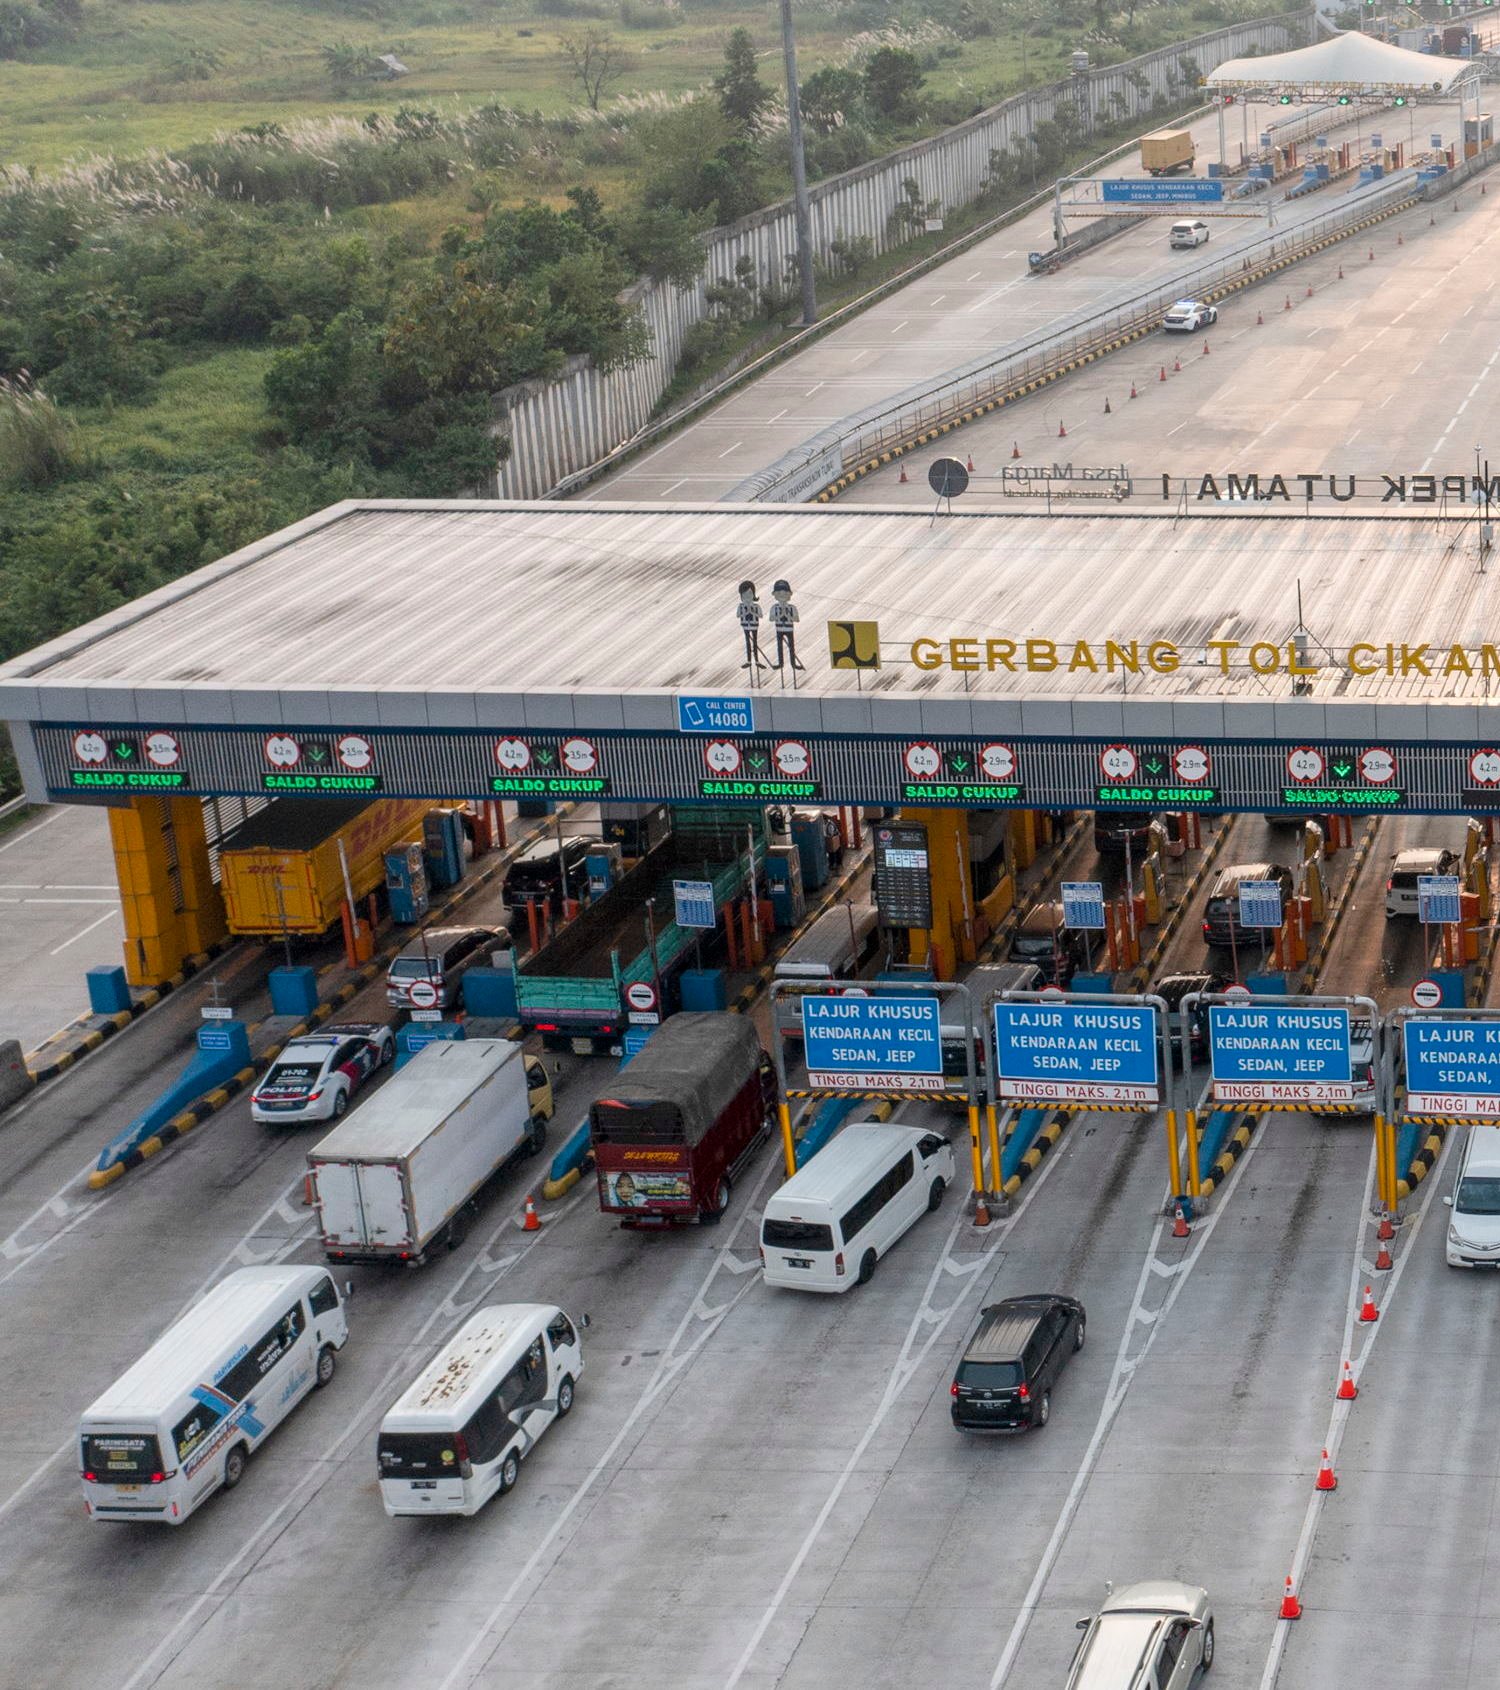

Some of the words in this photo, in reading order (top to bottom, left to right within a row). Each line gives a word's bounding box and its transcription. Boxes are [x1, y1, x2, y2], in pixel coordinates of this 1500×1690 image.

[910, 637, 1180, 675] GERBANG
[1207, 641, 1318, 676] TOL
[705, 701, 722, 710] CALL
[724, 702, 746, 711] CENTER
[708, 713, 748, 727] 14080
[74, 774, 124, 785] SALDO
[128, 775, 181, 785] CUKUP
[266, 776, 317, 787] SALDO
[321, 778, 374, 789] CUKUP
[494, 780, 545, 790] SALDO
[549, 780, 603, 791] CUKUP
[704, 783, 755, 794] SALDO
[760, 784, 814, 795] CUKUP
[906, 786, 958, 797] SALDO
[963, 787, 1018, 798] CUKUP
[1100, 789, 1153, 800] SALDO
[1157, 790, 1213, 800] CUKUP
[247, 864, 286, 874] DHL
[808, 1004, 860, 1018] LAJUR
[868, 1005, 933, 1019] KHUSUS
[1009, 1013, 1062, 1027] LAJUR
[1074, 1015, 1142, 1030] KHUSUS
[1216, 1015, 1268, 1028] LAJUR
[1277, 1015, 1343, 1029] KHUSUS
[809, 1026, 891, 1040] KENDARAAN
[898, 1028, 935, 1041] KECIL
[1419, 1030, 1474, 1043] LAJUR
[1011, 1036, 1097, 1050] KENDARAAN
[1105, 1039, 1142, 1052] KECIL
[1217, 1037, 1300, 1050] KENDARAAN
[1307, 1038, 1344, 1051] KECIL
[832, 1048, 880, 1062] SEDAN,
[885, 1050, 916, 1062] JEEP
[1033, 1056, 1082, 1071] SEDAN,
[1090, 1059, 1121, 1071] JEEP
[1238, 1059, 1288, 1072] SEDAN,
[1293, 1060, 1325, 1072] JEEP
[816, 1075, 859, 1086] TINGGI
[1439, 1071, 1492, 1085] SEDAN,
[1013, 1083, 1058, 1096] TINGGI
[1221, 1086, 1264, 1097] TINGGI
[1421, 1097, 1467, 1111] TINGGI
